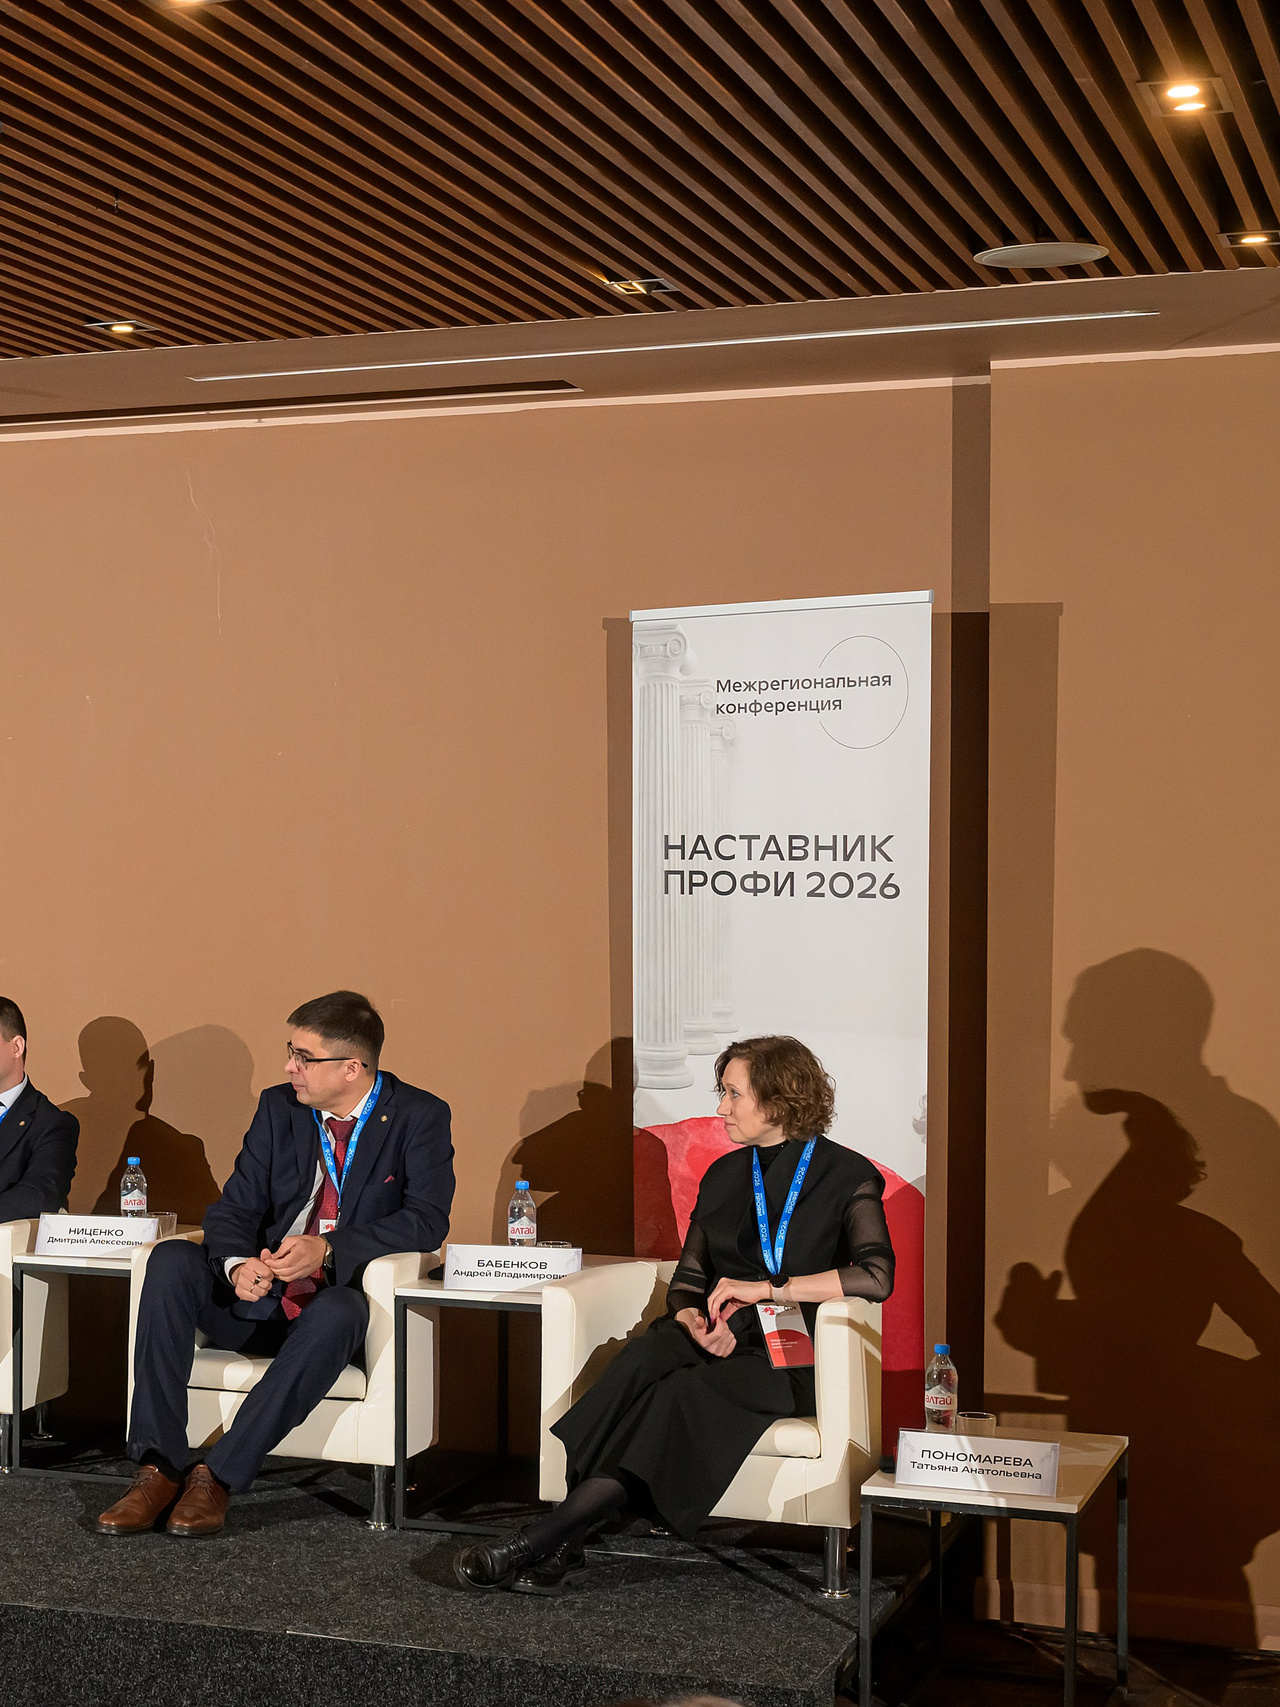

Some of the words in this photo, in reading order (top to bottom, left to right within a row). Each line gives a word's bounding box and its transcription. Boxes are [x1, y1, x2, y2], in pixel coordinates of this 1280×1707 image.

[716, 672, 893, 695] Межрегиональная
[715, 696, 843, 717] конференция
[663, 834, 895, 863] НАСТАВНИК
[663, 870, 797, 898] ПРОФИ
[805, 871, 902, 900] 2026
[753, 1169, 761, 1187] 2026
[796, 1166, 806, 1185] 2026
[124, 1198, 146, 1206] алтай
[788, 1191, 798, 1214] ПРОФИ
[68, 1227, 124, 1237] НИЦЕНКО
[510, 1226, 535, 1235] алтай
[778, 1220, 788, 1240] 2026
[46, 1236, 88, 1245] Дмитрий
[477, 1259, 548, 1270] БАБЕНКОВ
[453, 1269, 492, 1278] Андрей
[494, 1270, 567, 1280] Владимирови
[926, 1395, 952, 1405] алтай
[921, 1449, 1034, 1468] ПОНОМАРЕВА
[910, 1460, 959, 1474] Татьяна
[961, 1465, 1042, 1480] Анатольевна
